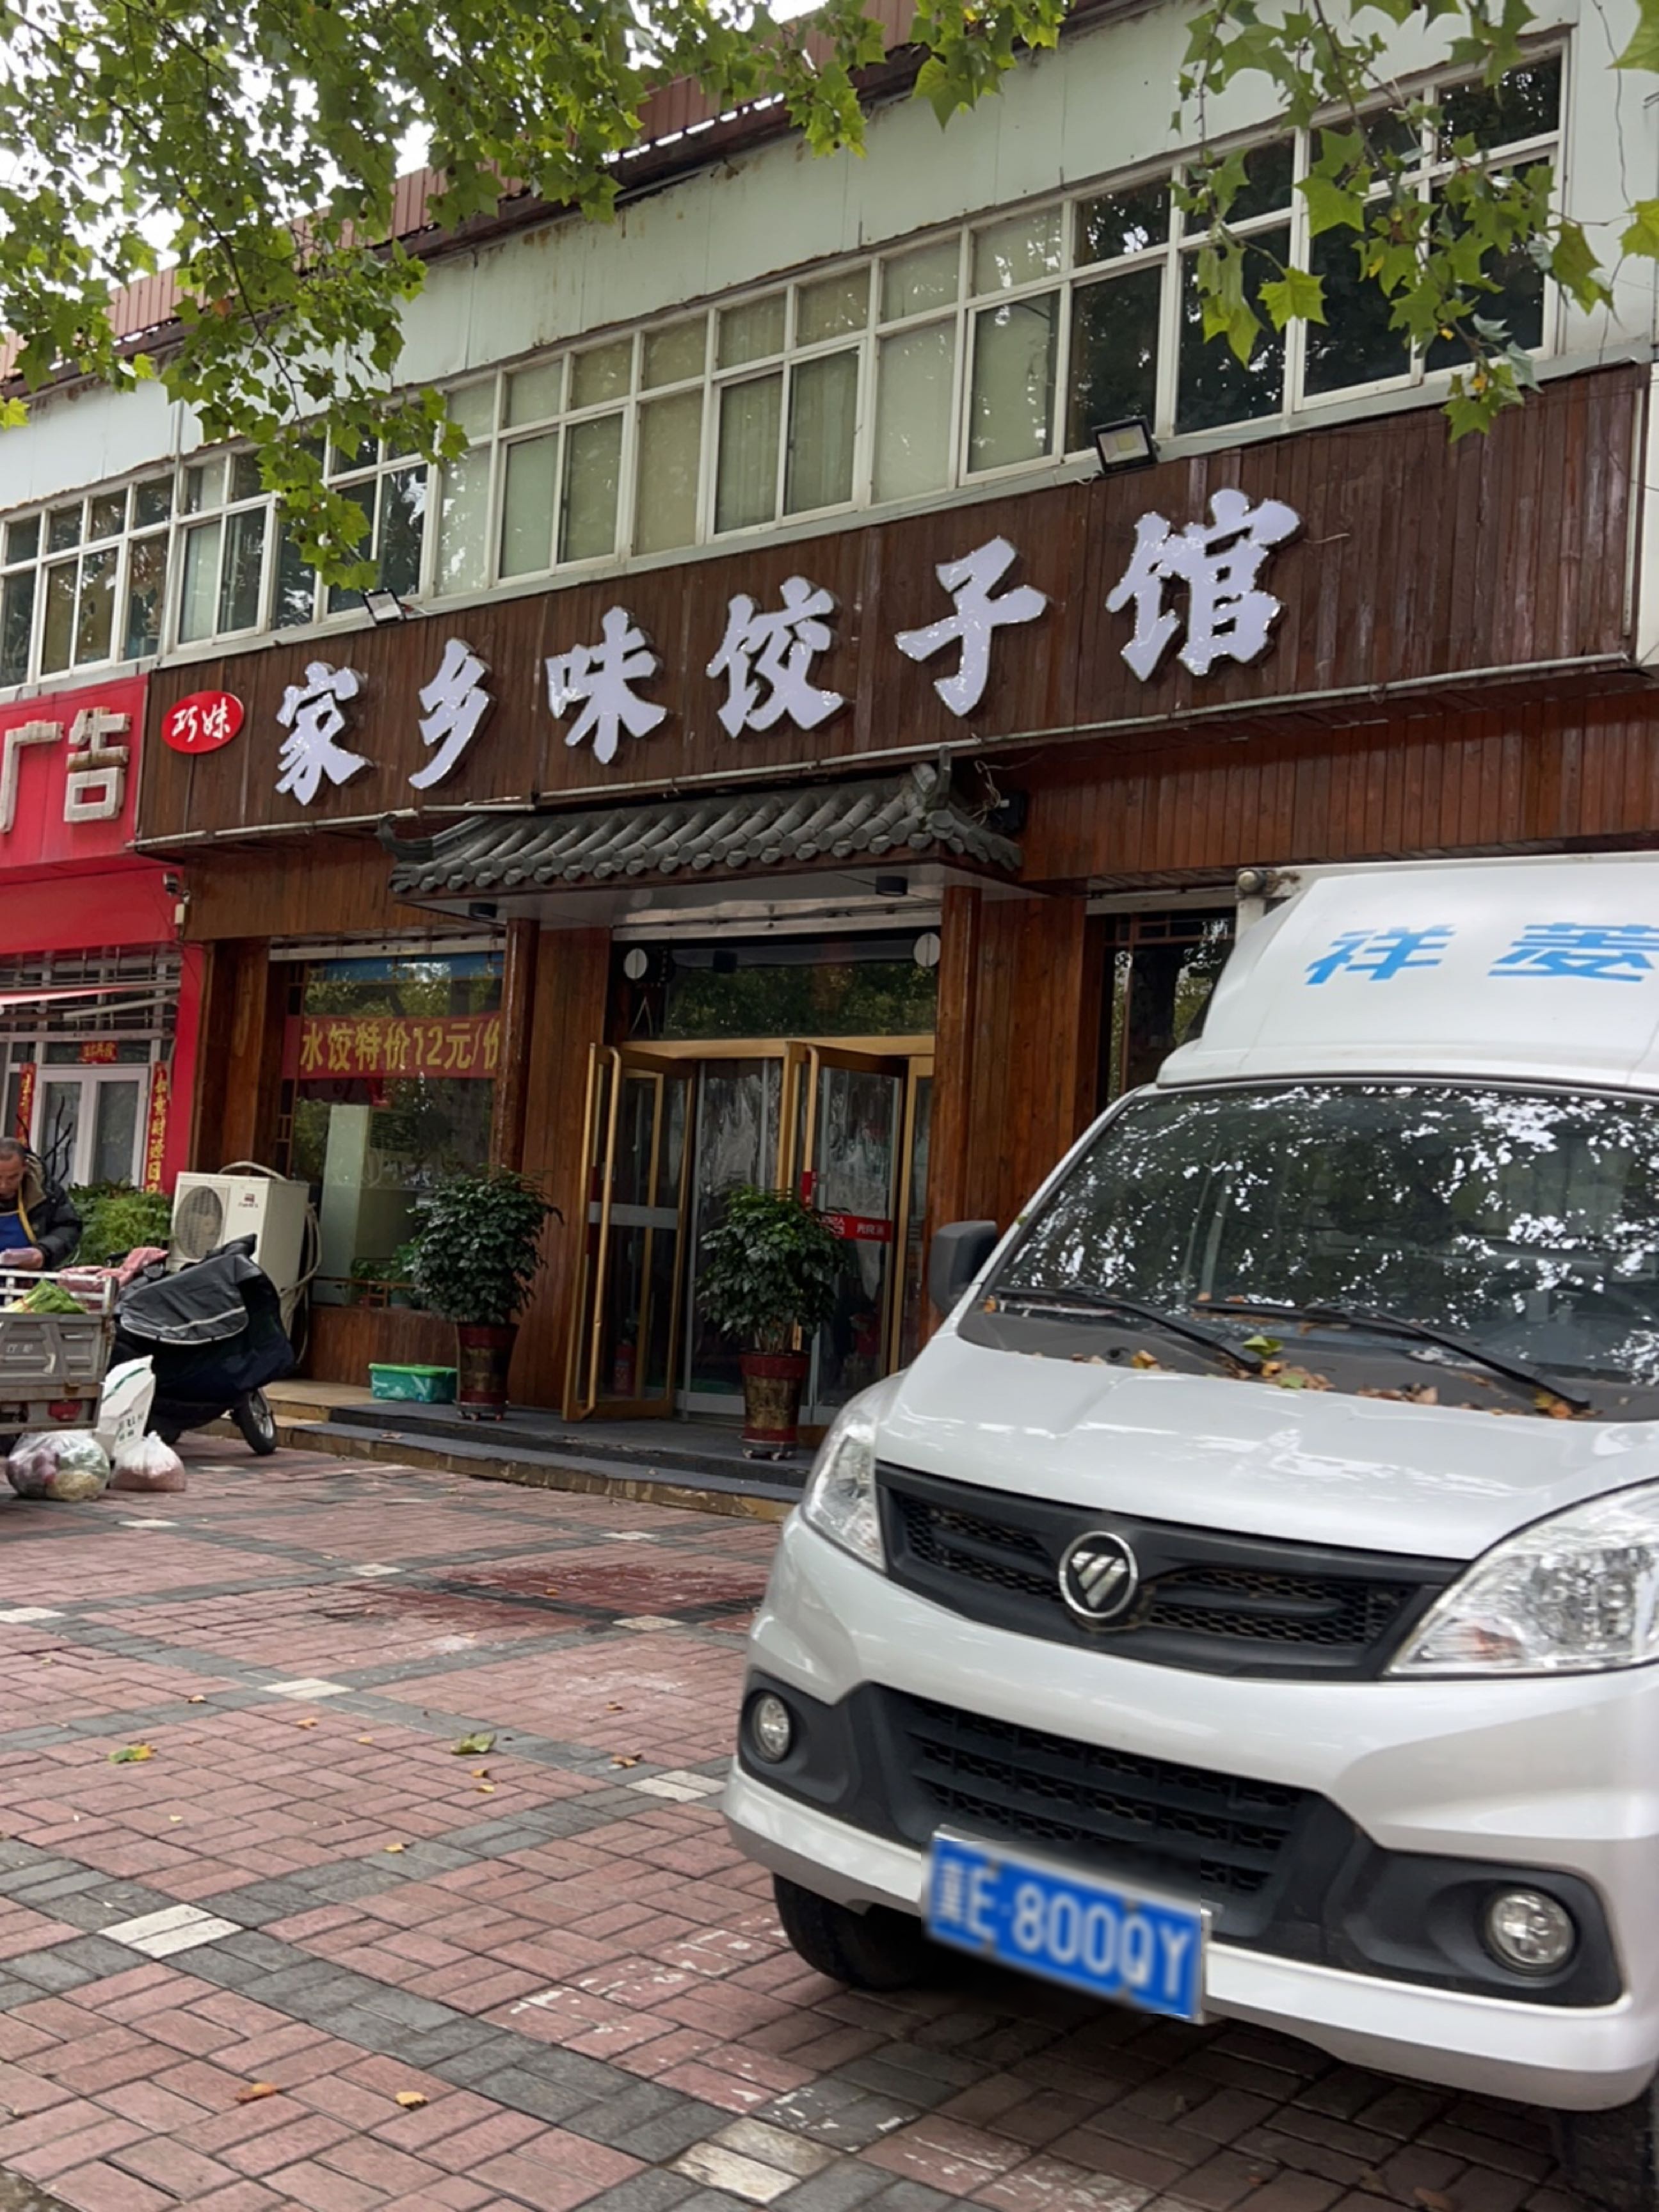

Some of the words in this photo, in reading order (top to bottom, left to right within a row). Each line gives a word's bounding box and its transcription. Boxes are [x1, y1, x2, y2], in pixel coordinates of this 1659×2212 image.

[275, 488, 1300, 805] 家乡味饺子馆
[0, 707, 131, 833] 广告
[1305, 922, 1659, 986] 祥菱
